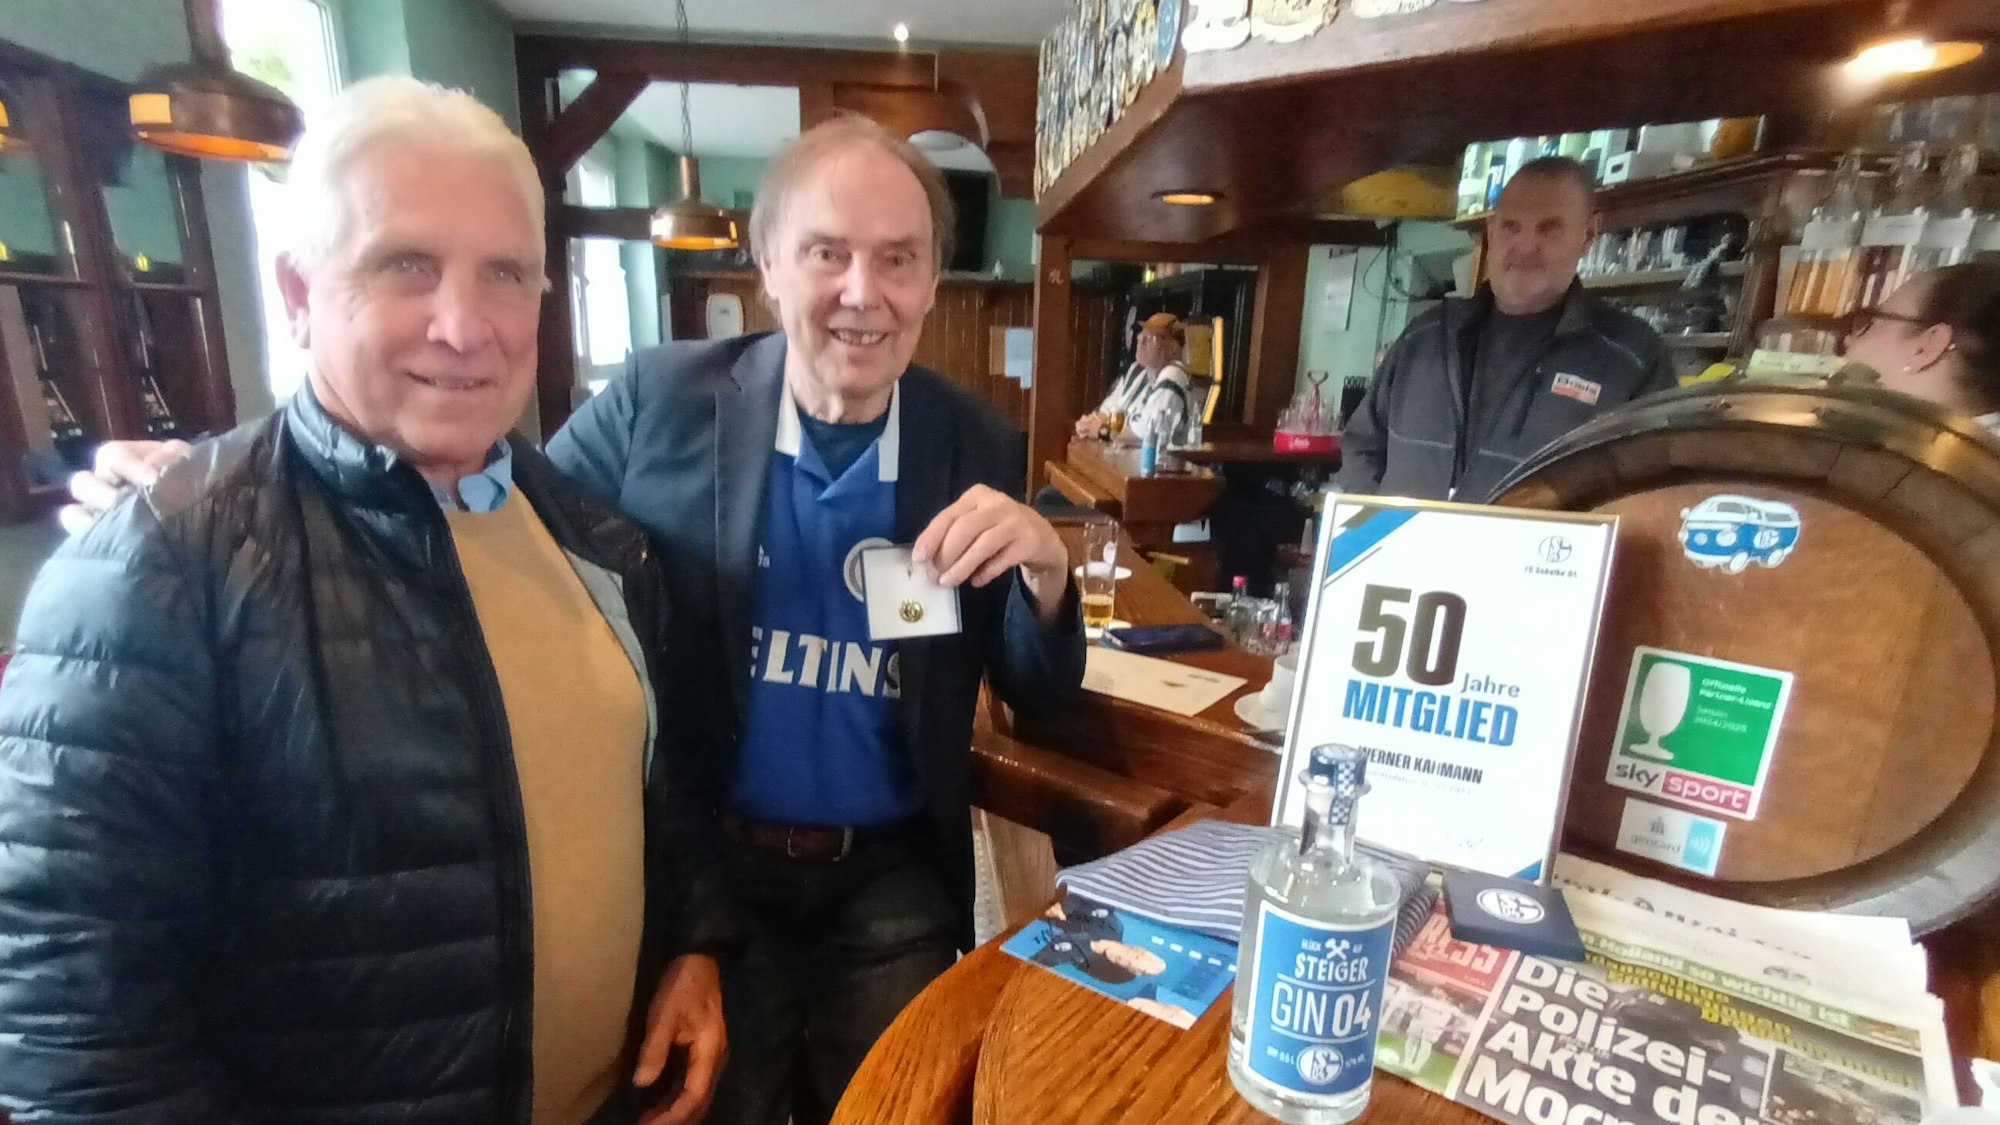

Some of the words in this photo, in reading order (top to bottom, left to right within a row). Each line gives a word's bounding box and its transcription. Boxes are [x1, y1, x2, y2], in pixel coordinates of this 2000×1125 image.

[1351, 583, 1467, 686] 50
[1460, 673, 1520, 698] Jahre
[1342, 679, 1518, 747] MITGLIED
[1615, 763, 1659, 788] sky
[1668, 776, 1746, 809] sport
[1294, 952, 1368, 982] STEIGER
[1515, 955, 1608, 1011] Die
[1270, 981, 1328, 1036] GIN
[1332, 989, 1371, 1037] 04
[1500, 984, 1731, 1086] Polizei-
[1484, 1020, 1636, 1105] Akte
